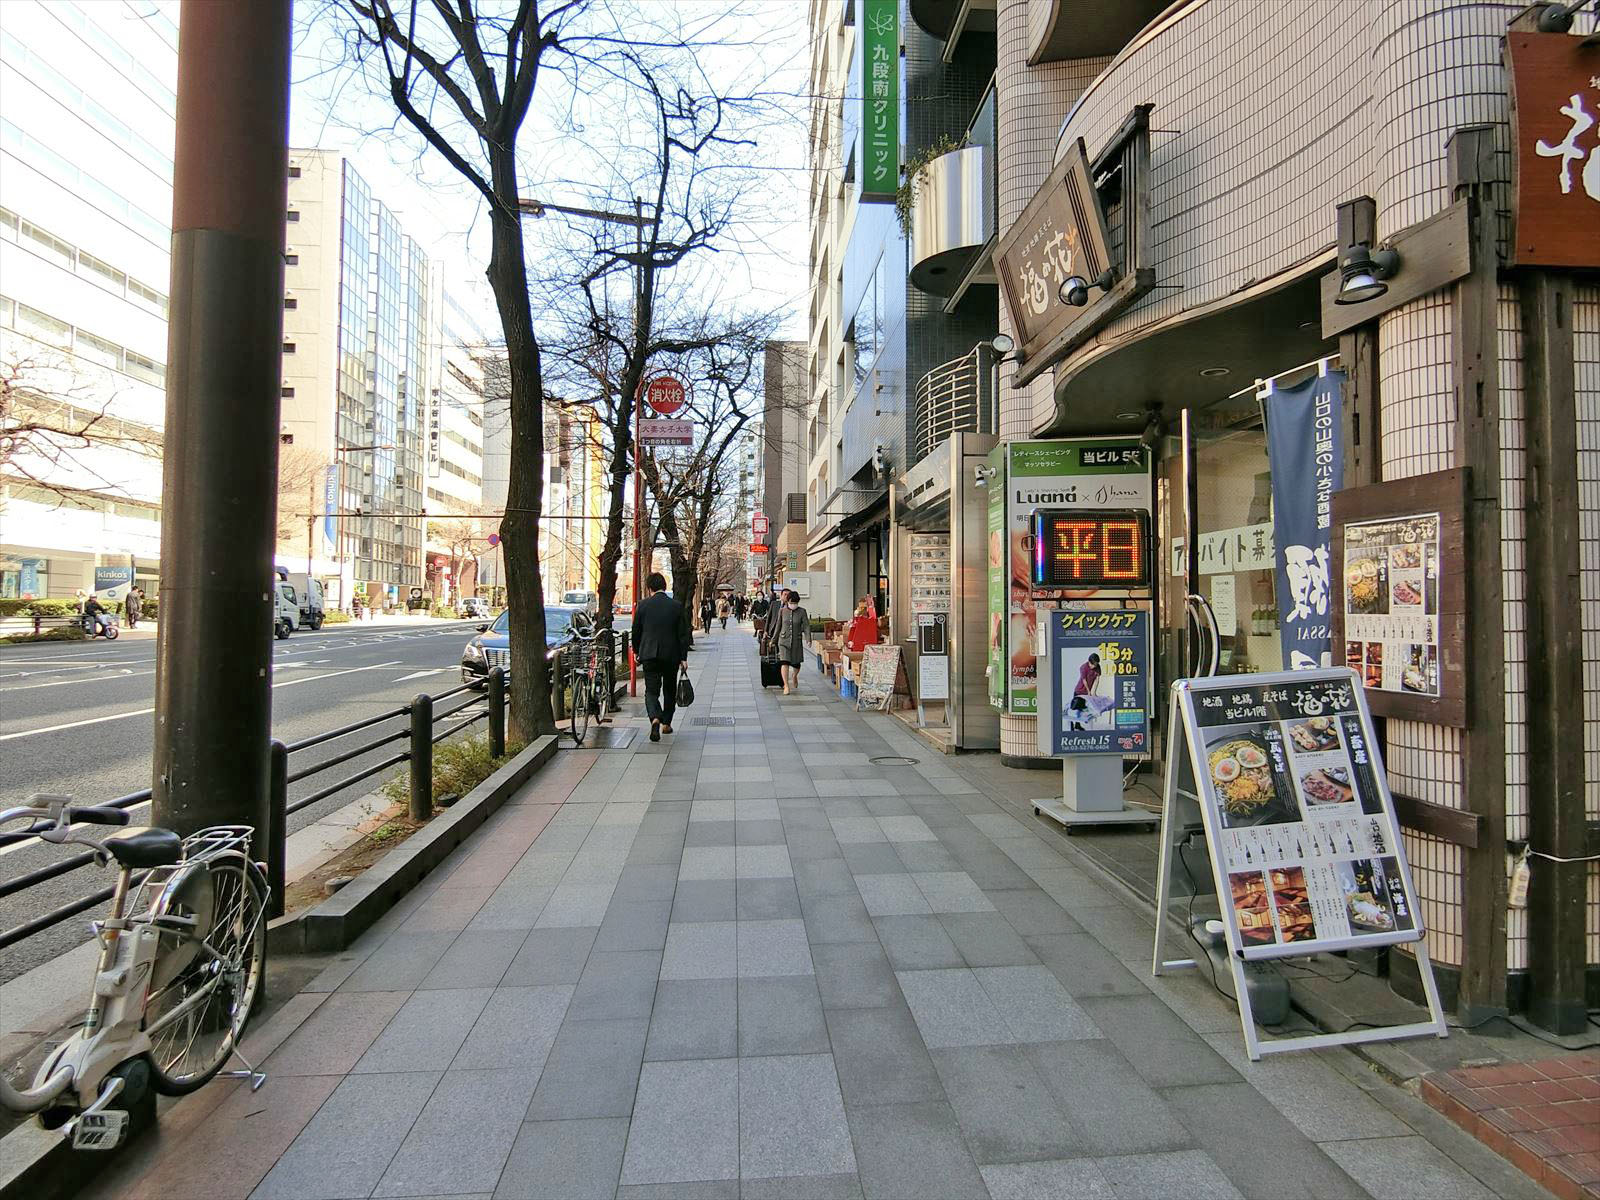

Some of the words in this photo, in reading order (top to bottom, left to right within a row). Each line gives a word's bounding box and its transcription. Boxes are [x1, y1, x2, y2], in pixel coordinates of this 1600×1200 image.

[872, 44, 890, 182] 九段南クリニック
[650, 388, 683, 403] 消火栓
[642, 426, 692, 434] 大妻女子大学
[1013, 449, 1072, 457] レディースシェービング
[1083, 450, 1120, 464] 当ビル
[1016, 488, 1077, 504] Luana
[1055, 522, 1138, 578] 平日
[96, 570, 128, 580] kinko's
[1061, 613, 1137, 629] クイックケア
[1098, 641, 1133, 662] 15分
[1202, 695, 1223, 708] 地酒
[1263, 689, 1289, 703] 瓦そば
[1225, 705, 1267, 720] 当ビル1階
[1061, 736, 1097, 746] Refresh
[1099, 734, 1111, 745] 15
